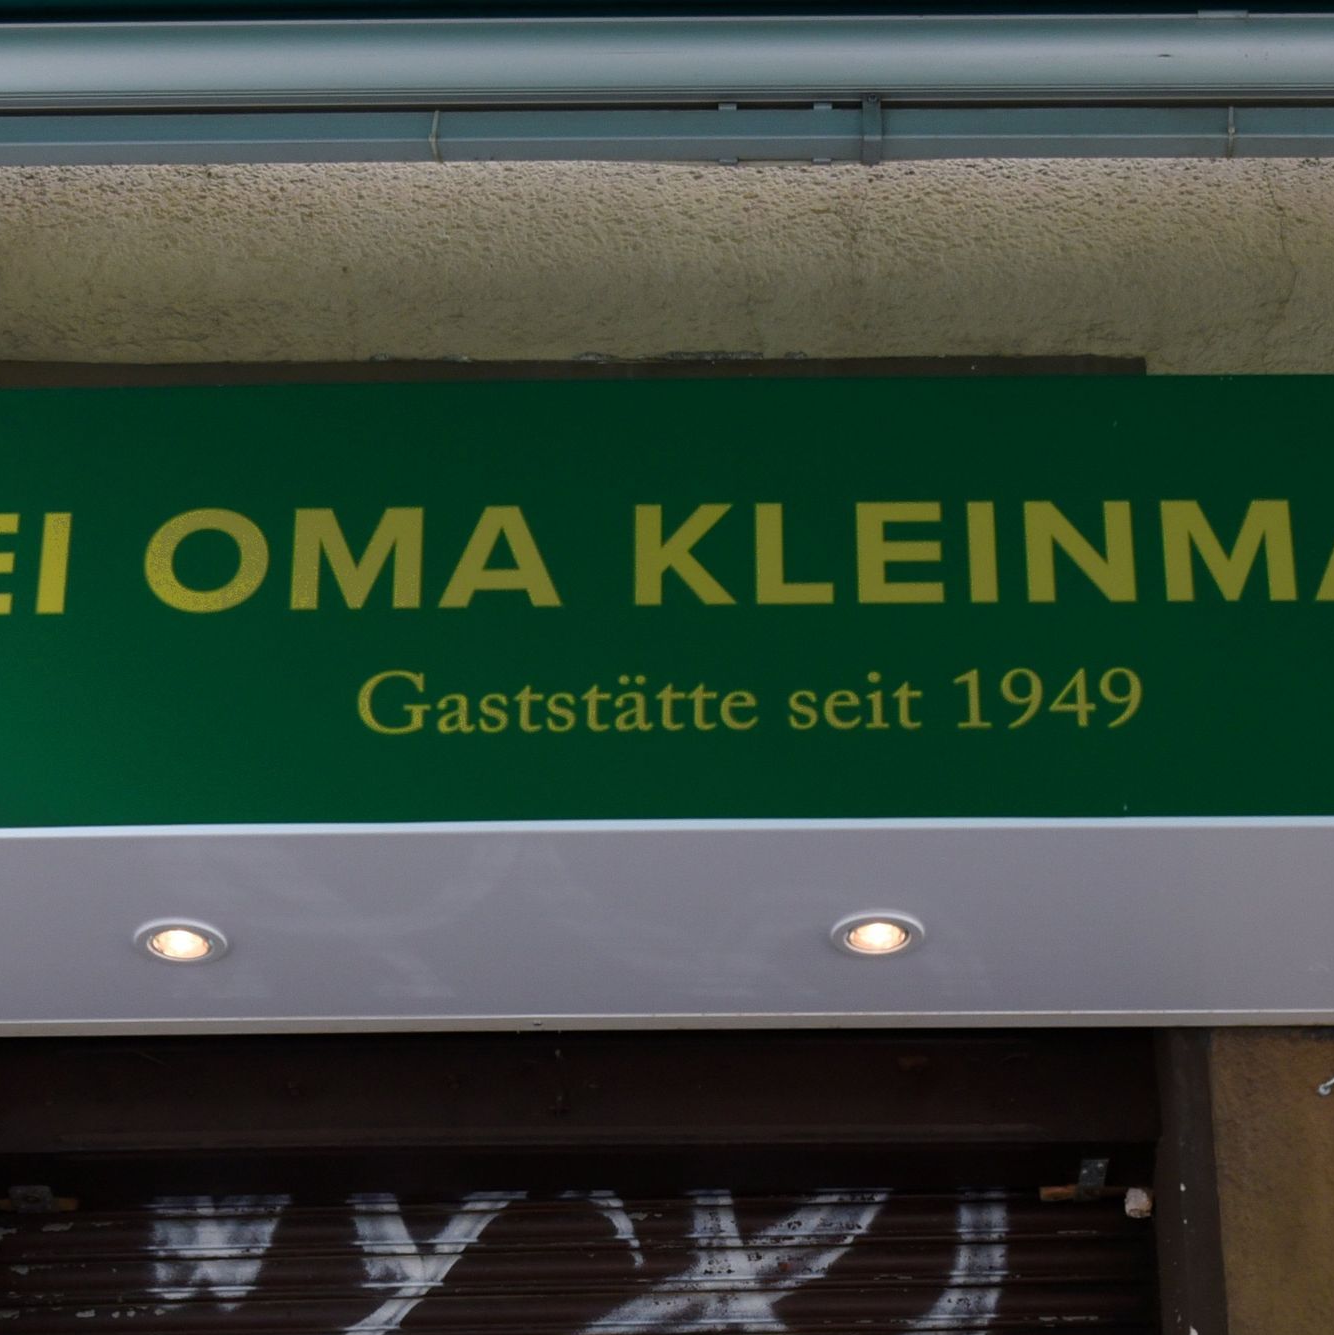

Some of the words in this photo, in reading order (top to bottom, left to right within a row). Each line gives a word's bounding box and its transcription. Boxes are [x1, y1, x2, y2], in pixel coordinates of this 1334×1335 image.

[142, 505, 562, 614] OMA
[356, 669, 759, 736] Gaststätte
[786, 670, 923, 731] seit
[952, 666, 1144, 731] 1949
